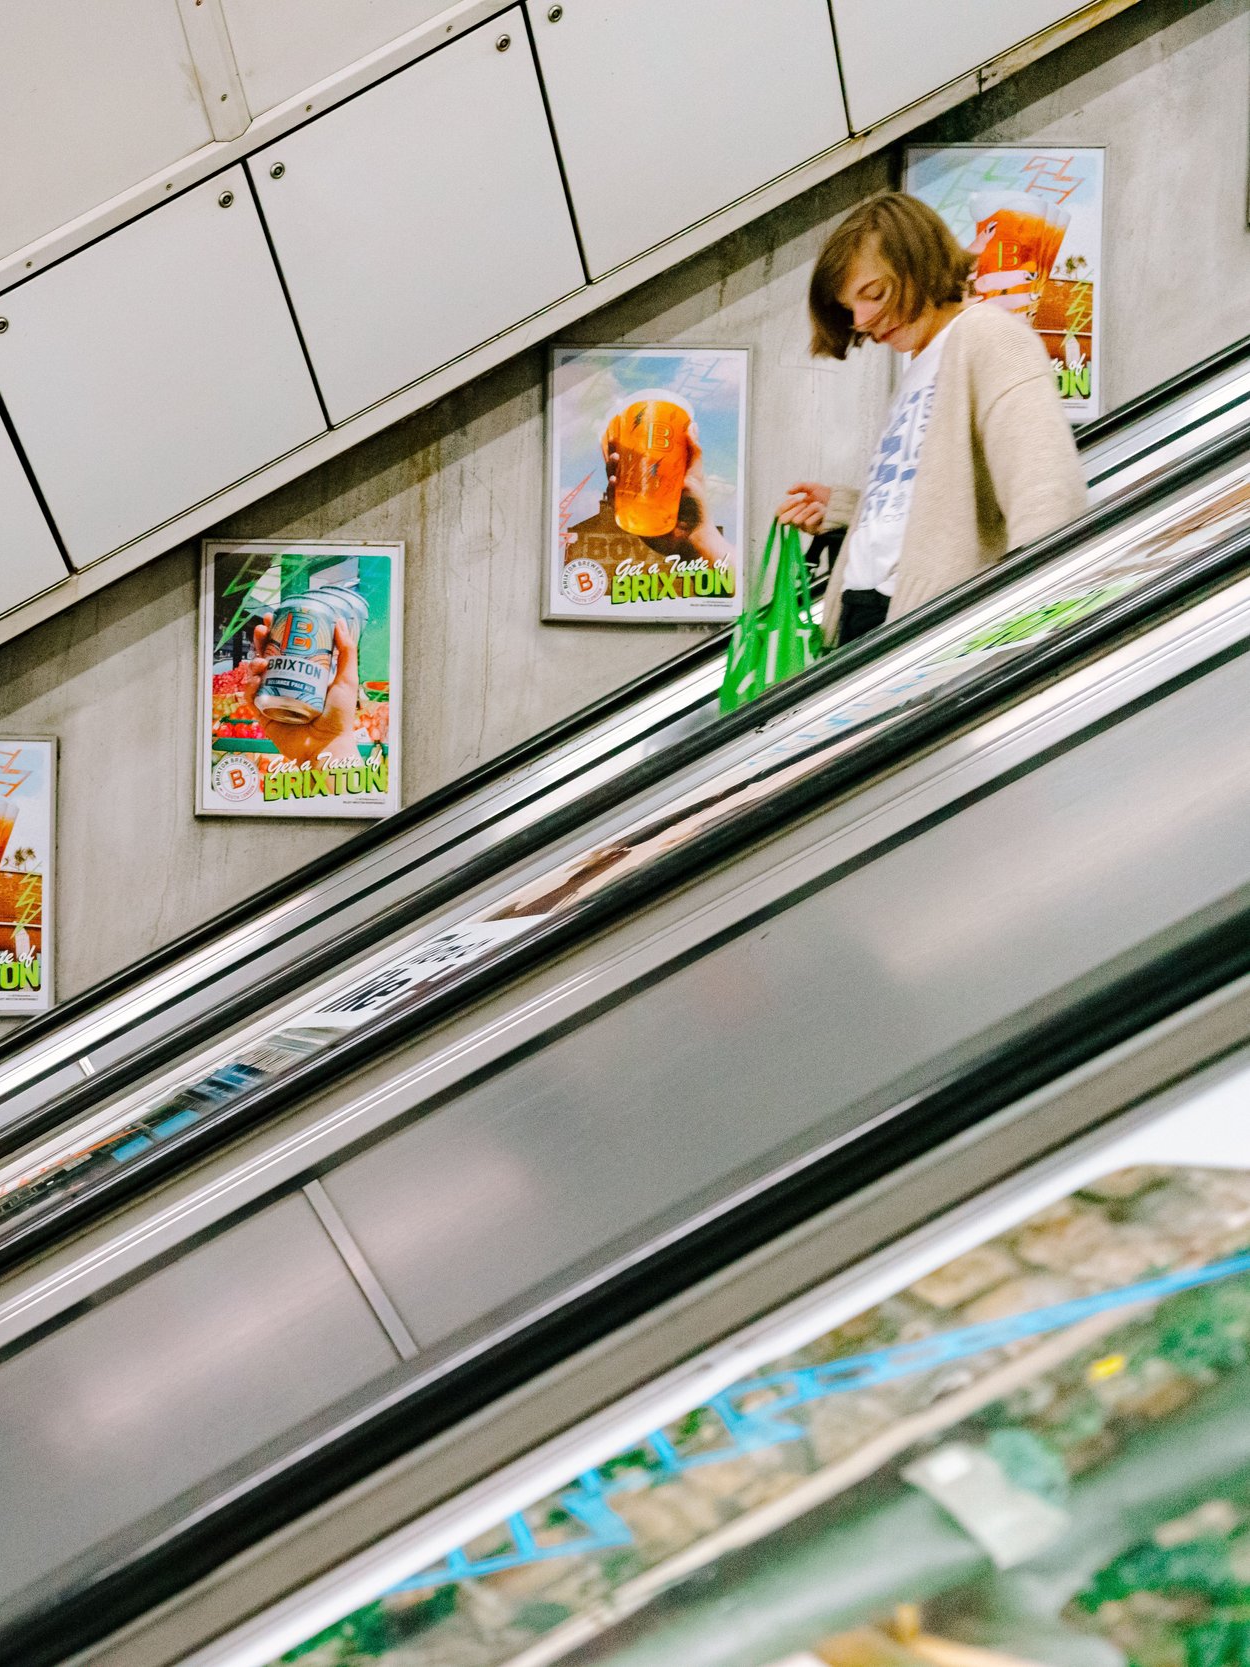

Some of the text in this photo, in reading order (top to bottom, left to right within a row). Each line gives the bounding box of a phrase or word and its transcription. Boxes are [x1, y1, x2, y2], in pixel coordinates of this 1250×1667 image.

[1067, 353, 1087, 377] of
[615, 553, 731, 583] Get a Taste of
[576, 572, 593, 592] B
[611, 567, 734, 605] BRIXTON
[281, 612, 318, 656] B
[267, 658, 322, 679] BRIXTON
[267, 749, 381, 780] Get a Taste of
[229, 769, 246, 789] B
[263, 764, 386, 802] BRIXTON
[19, 945, 36, 968] of
